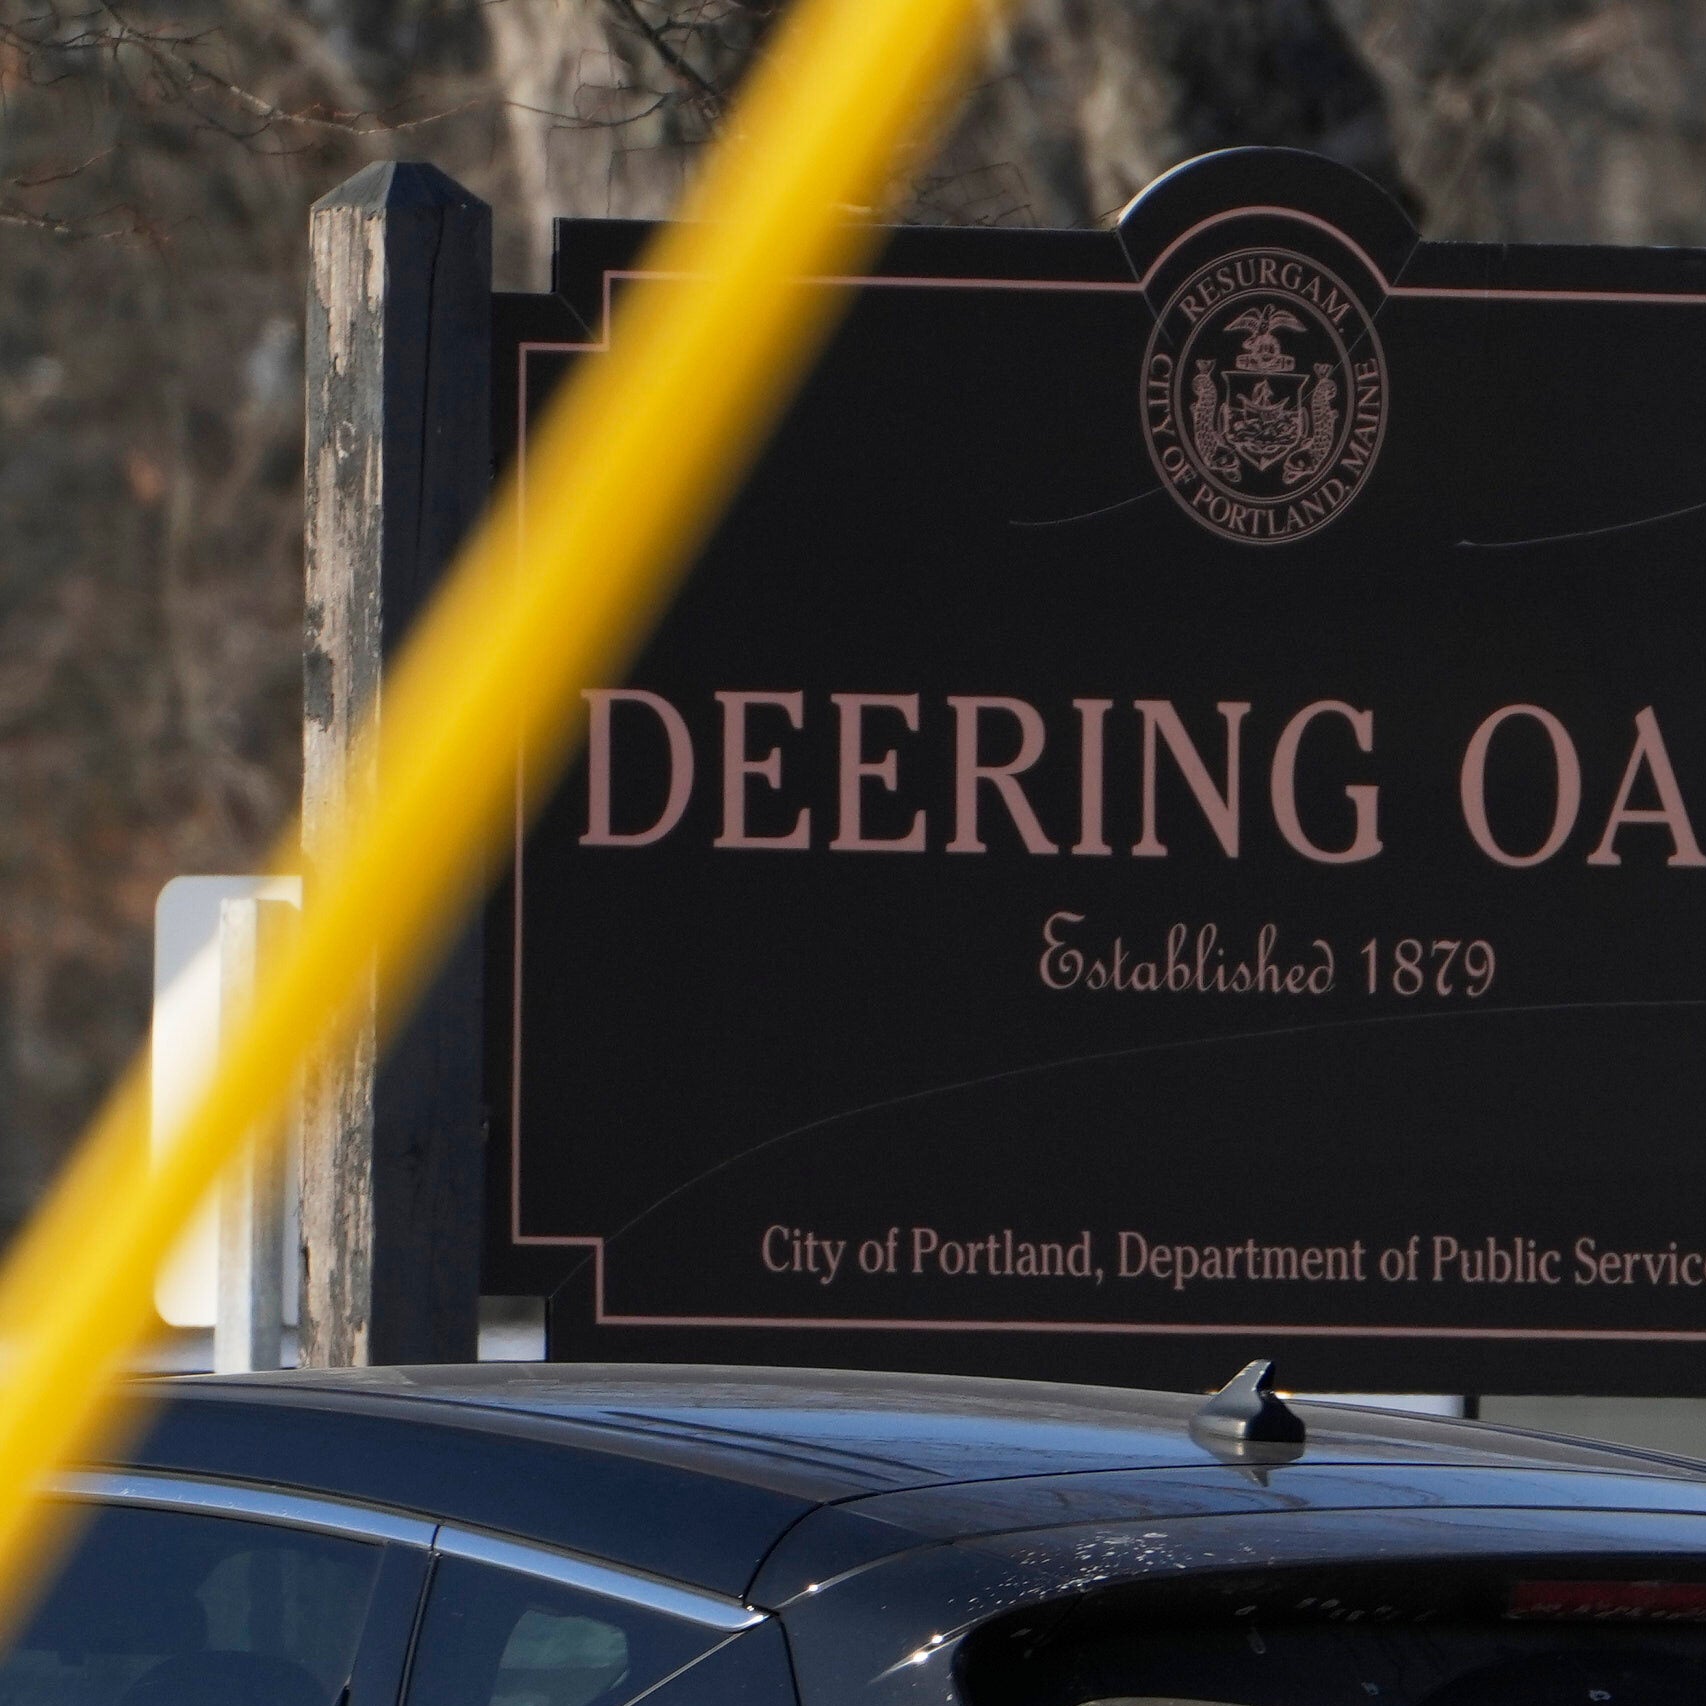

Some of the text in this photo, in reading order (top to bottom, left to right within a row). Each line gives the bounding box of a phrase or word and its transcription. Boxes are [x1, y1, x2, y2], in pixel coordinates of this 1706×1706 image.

[1149, 352, 1175, 435] CITY
[1163, 445, 1199, 487] OF
[1340, 356, 1381, 478] MAINE
[578, 687, 1384, 864] DEERING
[1038, 910, 1497, 998] Established 1879
[760, 1223, 848, 1286] City
[858, 1226, 900, 1276] of
[910, 1226, 1105, 1287] Portland,
[1117, 1230, 1368, 1291] Department
[1378, 1234, 1421, 1282] of
[1431, 1234, 1563, 1285] Public
